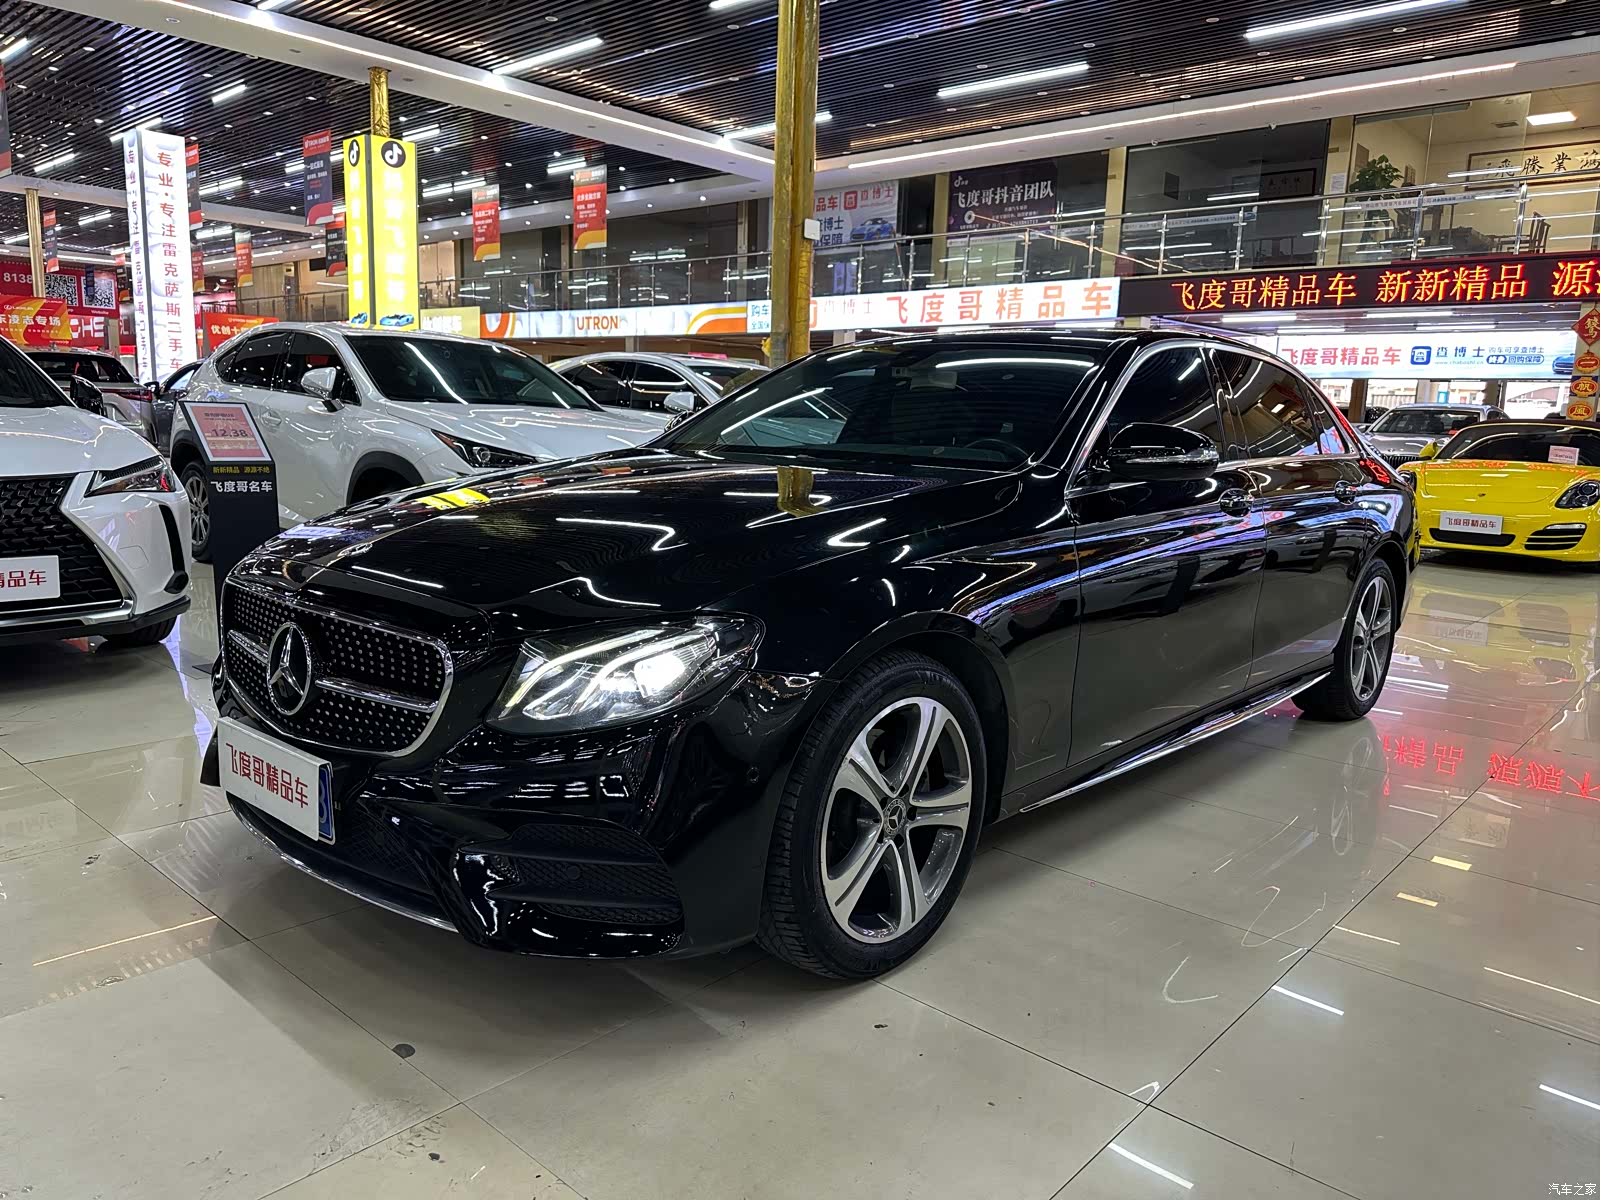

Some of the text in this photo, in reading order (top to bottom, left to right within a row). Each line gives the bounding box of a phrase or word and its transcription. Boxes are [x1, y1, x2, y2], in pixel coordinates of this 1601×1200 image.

[812, 194, 839, 213] 品车
[953, 180, 1054, 208] 飞度哥抖音团队
[1171, 260, 1600, 311] 飞度哥精品车 新新精品 源
[887, 281, 1112, 324] 飞度哥精品车
[576, 315, 619, 331] UTRON
[1281, 346, 1402, 366] 飞度哥精品车
[211, 428, 248, 438] 12.38
[210, 481, 272, 493] 飞度哥名车
[226, 742, 309, 809] 飞度哥精品车
